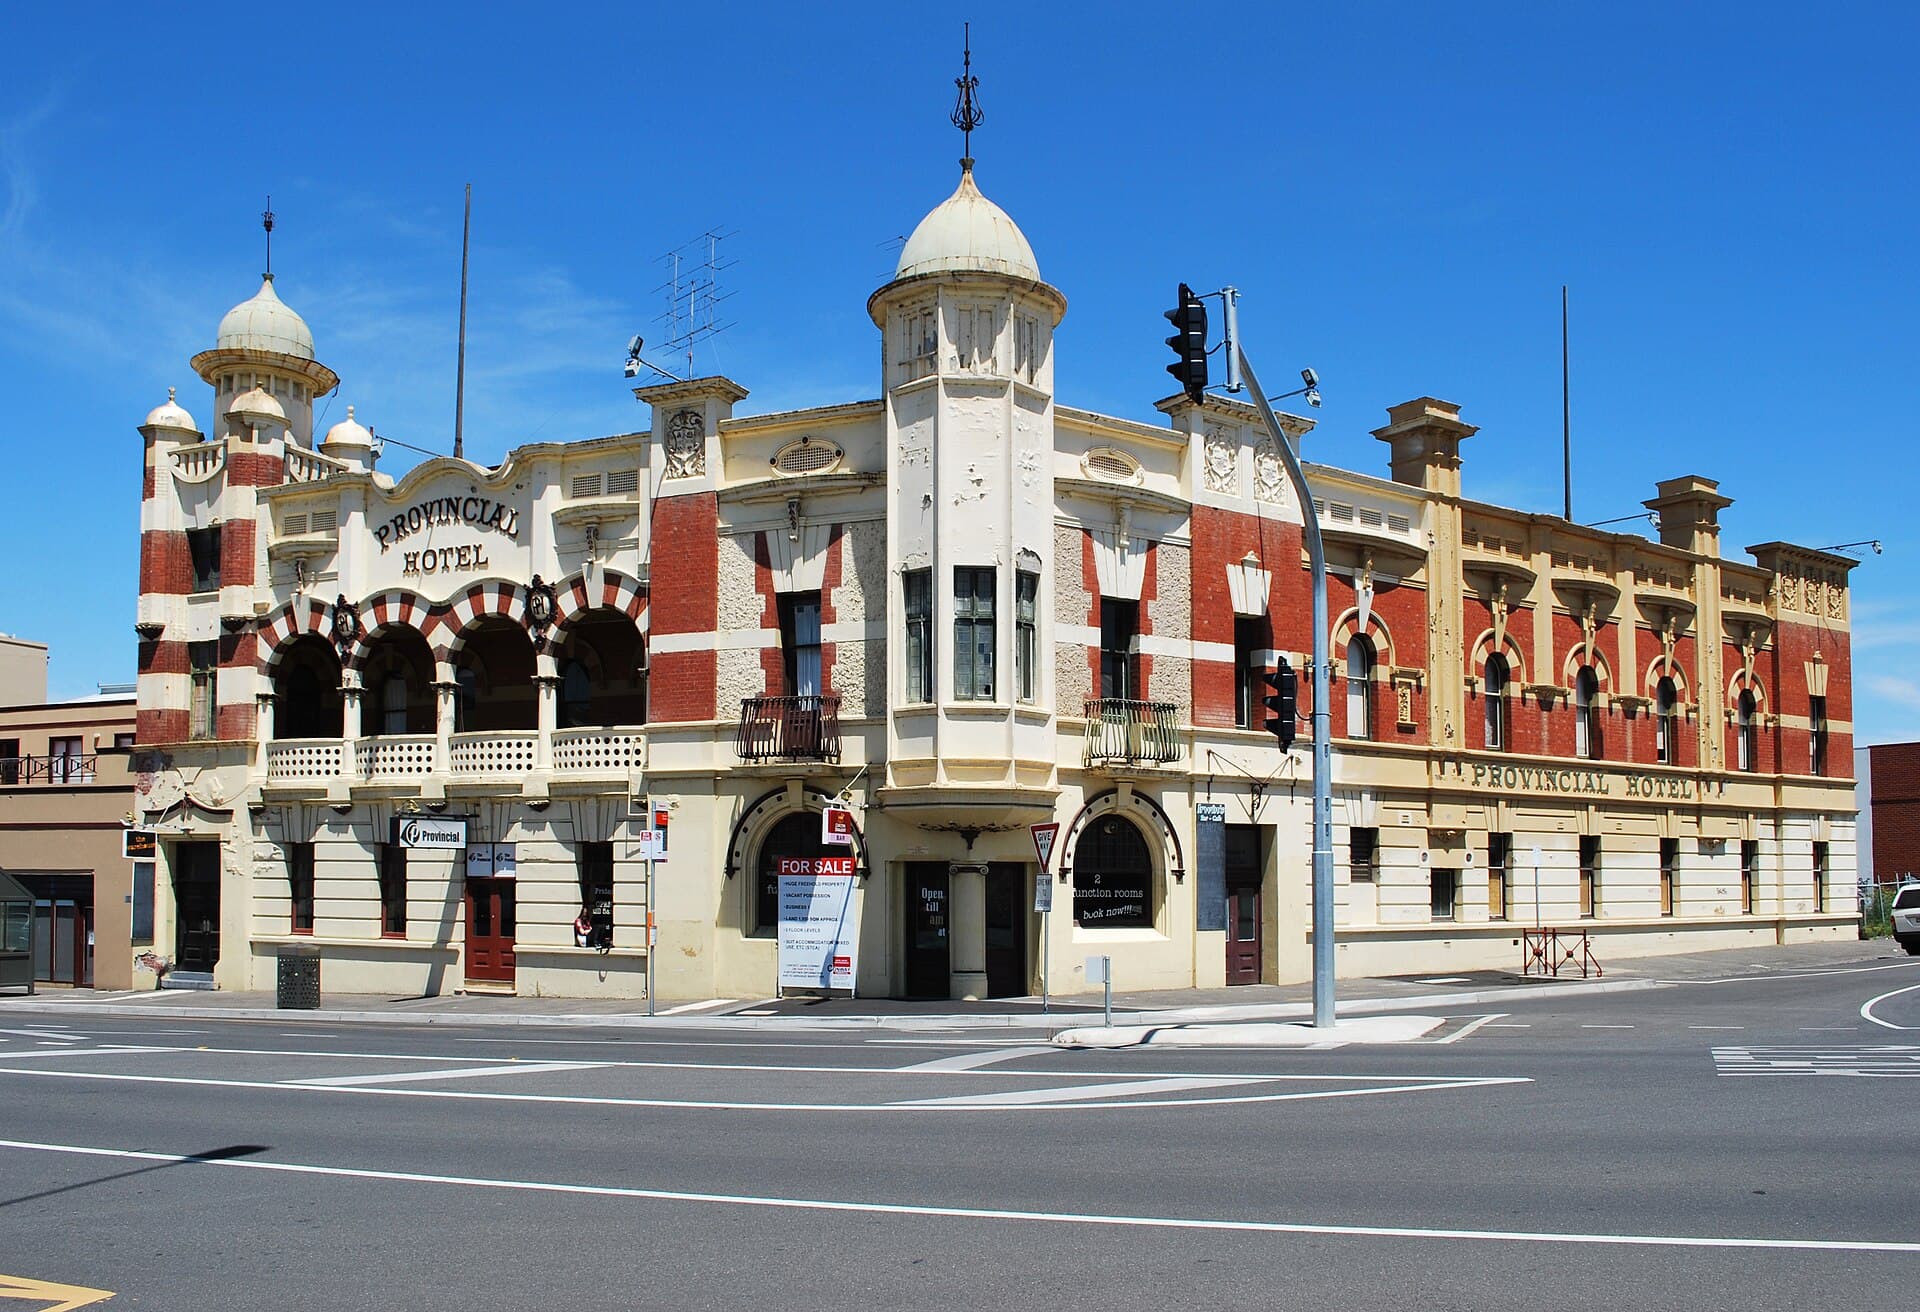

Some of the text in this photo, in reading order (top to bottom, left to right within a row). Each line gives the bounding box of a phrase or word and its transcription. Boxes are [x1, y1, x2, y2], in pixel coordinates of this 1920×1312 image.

[374, 496, 519, 551] PROVINCIAL
[403, 544, 489, 574] HOTEL
[1471, 763, 1692, 799] PROVINCIAL HOTEL
[422, 830, 460, 843] Provincial
[1038, 832, 1051, 841] GIVE
[782, 860, 852, 874] FOR SALE
[1094, 874, 1101, 884] 2
[921, 887, 944, 901] Open
[1072, 887, 1144, 898] function rooms
[926, 901, 939, 912] till
[1083, 908, 1104, 920] book
